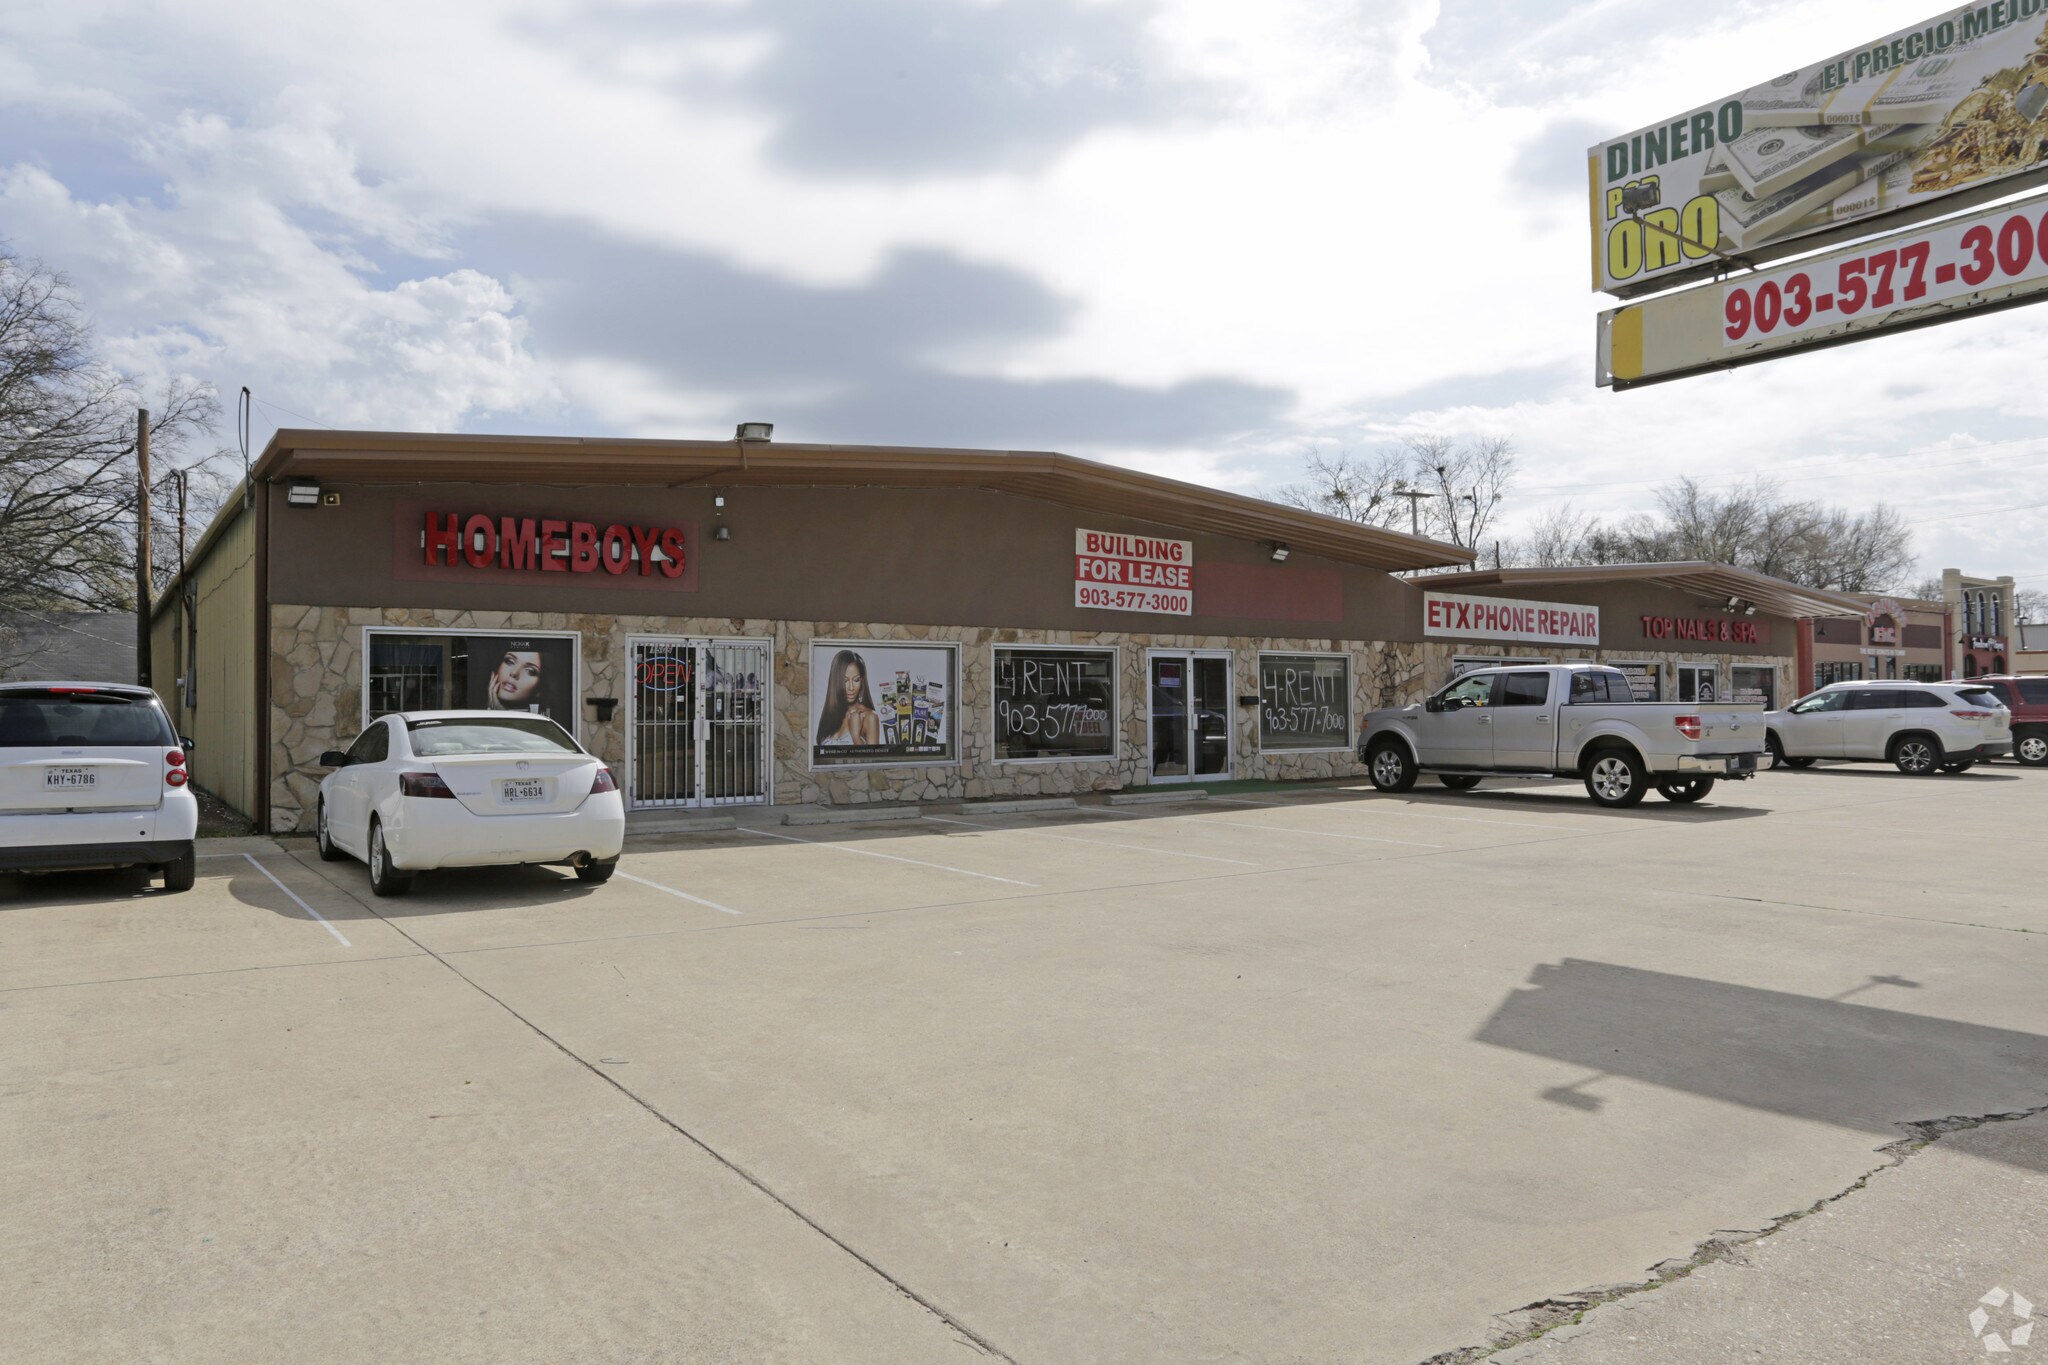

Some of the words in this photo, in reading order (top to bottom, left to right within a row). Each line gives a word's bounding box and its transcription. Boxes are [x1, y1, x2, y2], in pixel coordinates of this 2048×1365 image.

[1823, 61, 1849, 91] EL
[1855, 21, 1955, 80] PRECIO
[1607, 100, 1743, 184] DINERO
[1606, 174, 1661, 221] PR
[1608, 194, 1720, 281] ORO
[424, 511, 687, 579] HOMEBOYS
[1086, 533, 1183, 561] BUILDING
[1079, 557, 1121, 581] FOR
[1128, 562, 1189, 588] LEASE
[1080, 588, 1188, 613] 903-577-3000
[1427, 600, 1470, 629] ETX
[1474, 604, 1534, 632] PHONE
[1538, 609, 1597, 637] REPAIR
[1641, 616, 1673, 639] TOP
[1676, 618, 1717, 641] NAILS
[1720, 622, 1729, 641] &
[1733, 623, 1758, 643] SPA
[636, 663, 692, 684] OPEN
[1266, 706, 1345, 734] 903-577-7000
